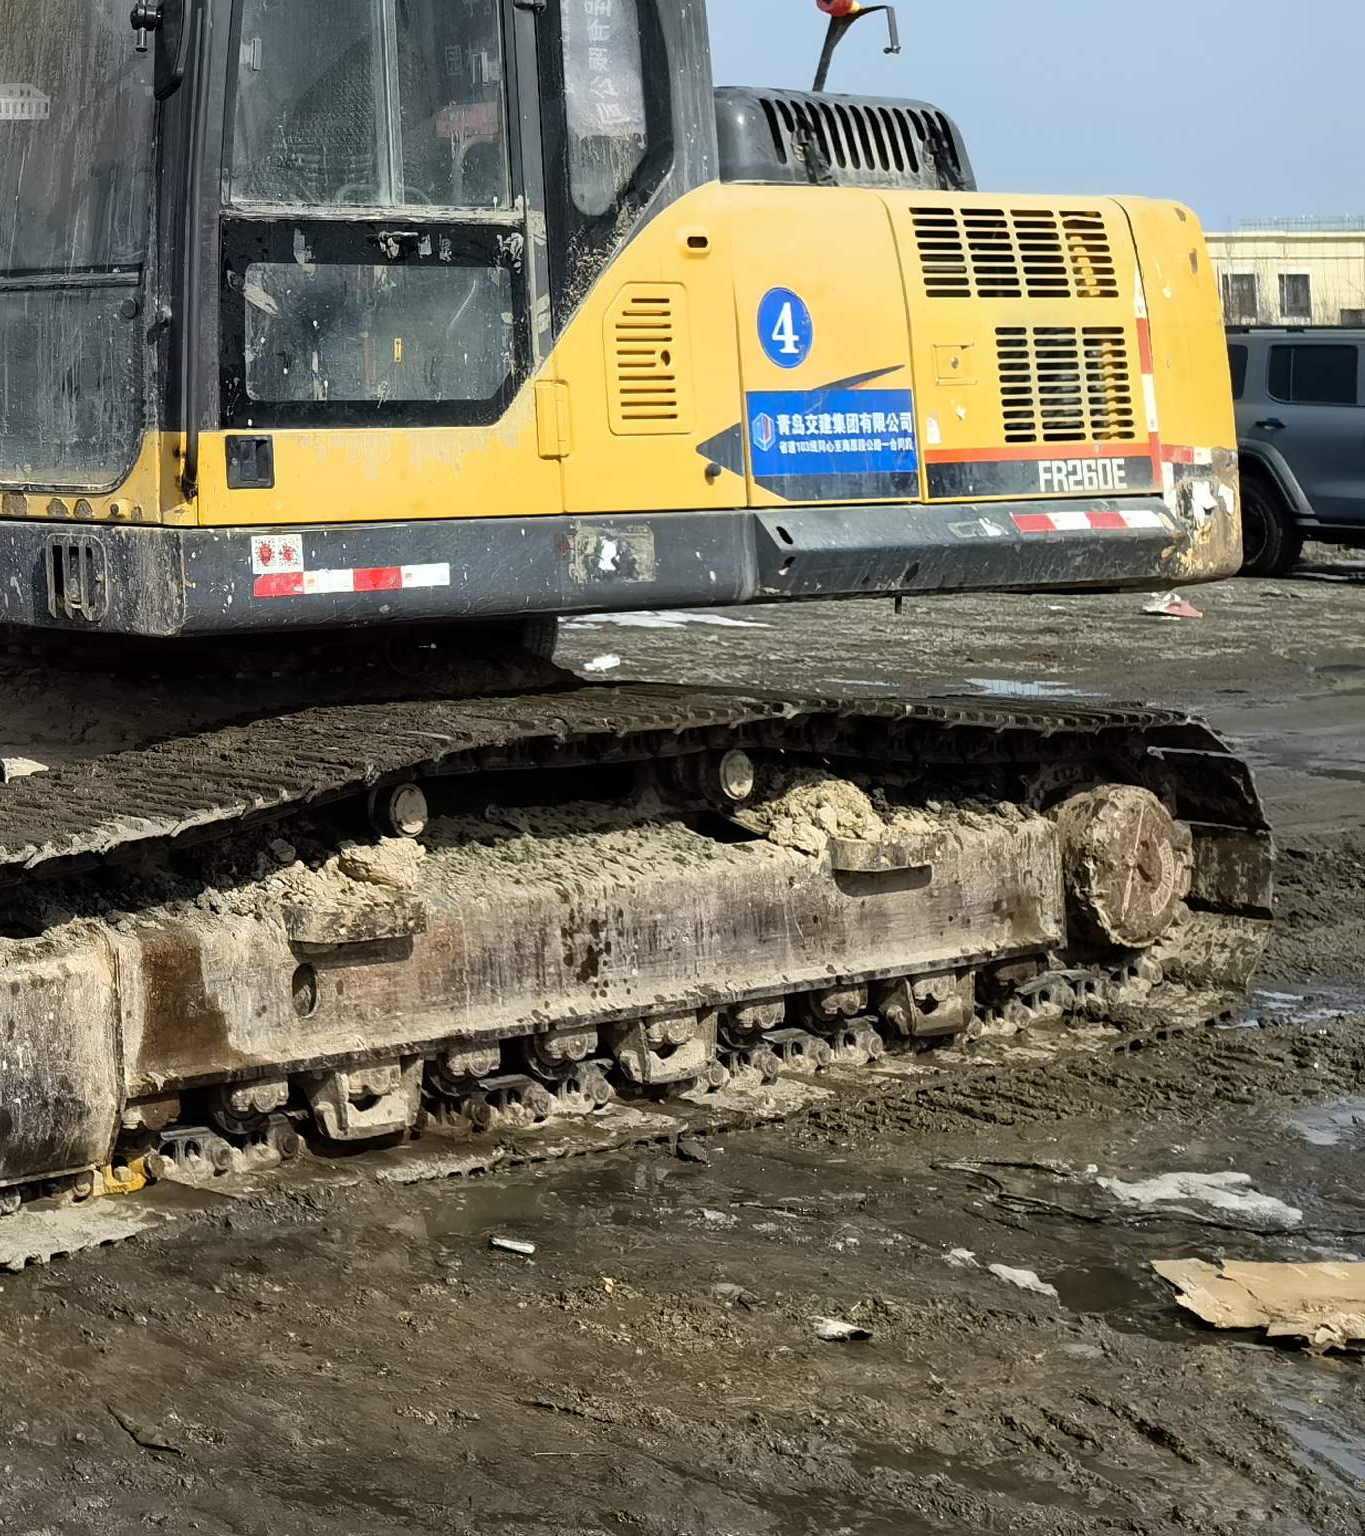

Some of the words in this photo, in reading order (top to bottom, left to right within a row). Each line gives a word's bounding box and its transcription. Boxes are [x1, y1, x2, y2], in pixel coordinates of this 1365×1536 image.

[771, 301, 800, 355] 4
[776, 411, 913, 436] 青岛交建集团有限公司
[1038, 457, 1128, 492] FR260E
